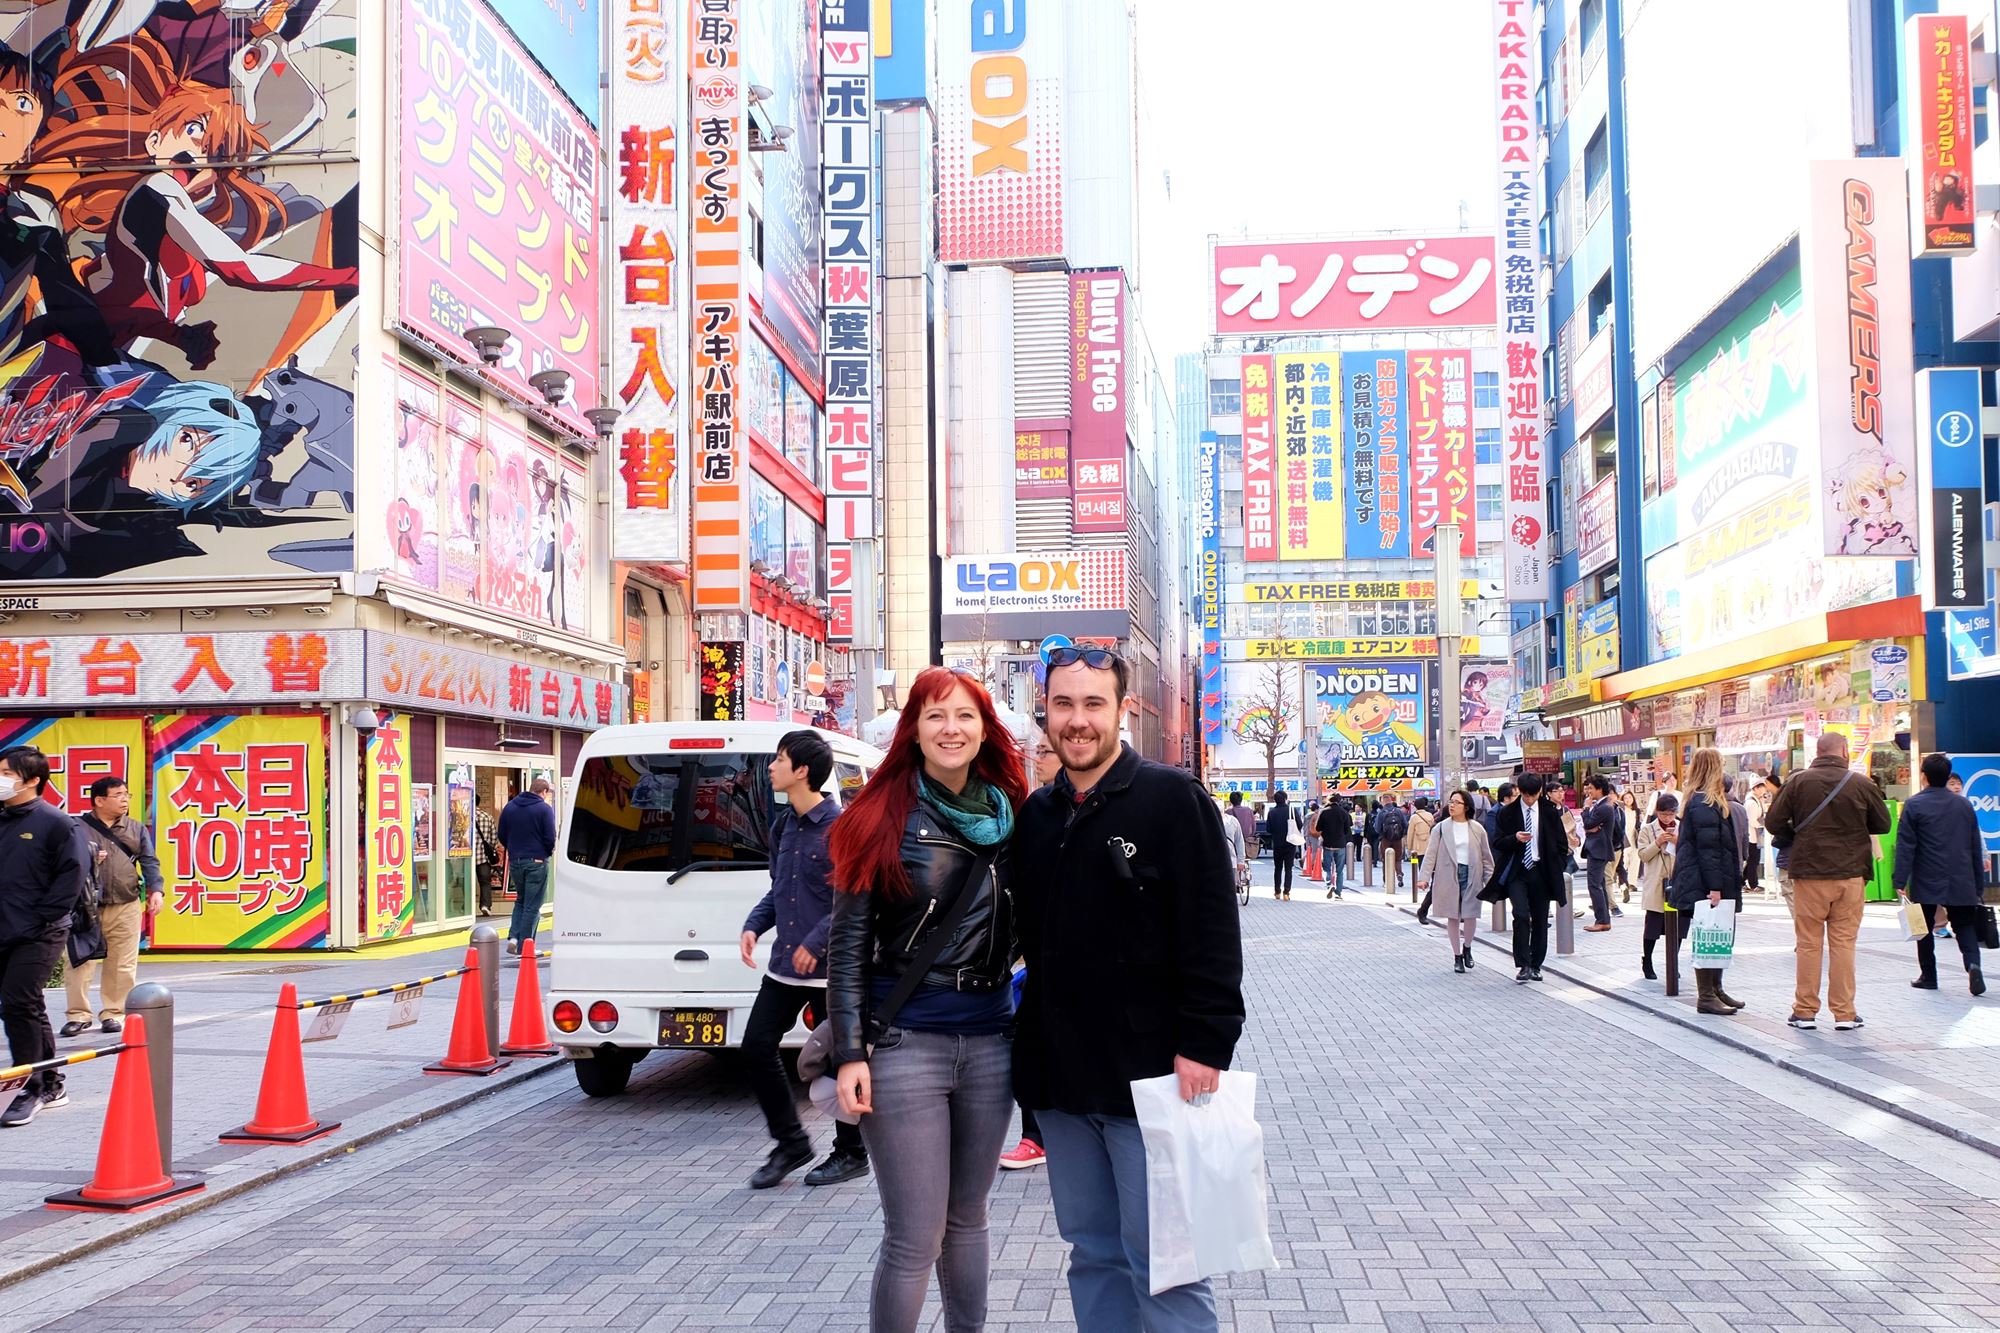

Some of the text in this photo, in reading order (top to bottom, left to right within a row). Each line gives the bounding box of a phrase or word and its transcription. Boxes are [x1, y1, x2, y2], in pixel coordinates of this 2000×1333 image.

[1498, 1, 1531, 162] TAKARADA
[1935, 41, 1956, 167] カードキングダム
[700, 117, 732, 223] まっくす
[618, 124, 676, 510] 新台入替
[1219, 239, 1493, 321] オノデン
[1505, 254, 1535, 334] 免税商店
[1843, 178, 1884, 445] GAMERS
[1073, 280, 1089, 382] Flagship Store
[1089, 278, 1123, 412] Duty Free
[703, 306, 732, 481] アキバ駅前店
[1506, 341, 1541, 502] 歓迎光臨
[1949, 415, 1961, 442] DELL
[1016, 434, 1041, 447] 本店
[1245, 364, 1272, 549] 免税 TAX FREE
[1310, 362, 1333, 502] 冷蔵庫 洗濯機
[1353, 373, 1375, 524] お見積り無料です
[1079, 464, 1119, 484] 免税
[1079, 500, 1121, 516] 면세점
[1200, 442, 1217, 538] Panasonic
[1951, 493, 1964, 590] ALIENWARE
[956, 594, 1081, 607] Home Electronics Store
[1203, 550, 1218, 629] ONODEN
[1255, 585, 1294, 600] TAX
[1299, 584, 1350, 599] FREE
[1354, 583, 1400, 598] 免税店
[1974, 616, 1990, 630] Site
[0, 633, 330, 697] 新台入替
[1256, 641, 1297, 656] テレビ
[1302, 641, 1346, 656] 冷蔵庫
[1352, 641, 1408, 654] エアコン
[1338, 667, 1378, 676] Welcome
[508, 663, 613, 726] 新台入替
[170, 744, 309, 816] 本日
[1327, 779, 1403, 790] オノデン
[1338, 766, 1420, 779] レビはオノデンで!
[168, 816, 312, 882] 10時
[173, 880, 308, 915] オープン
[696, 1012, 714, 1023] 480
